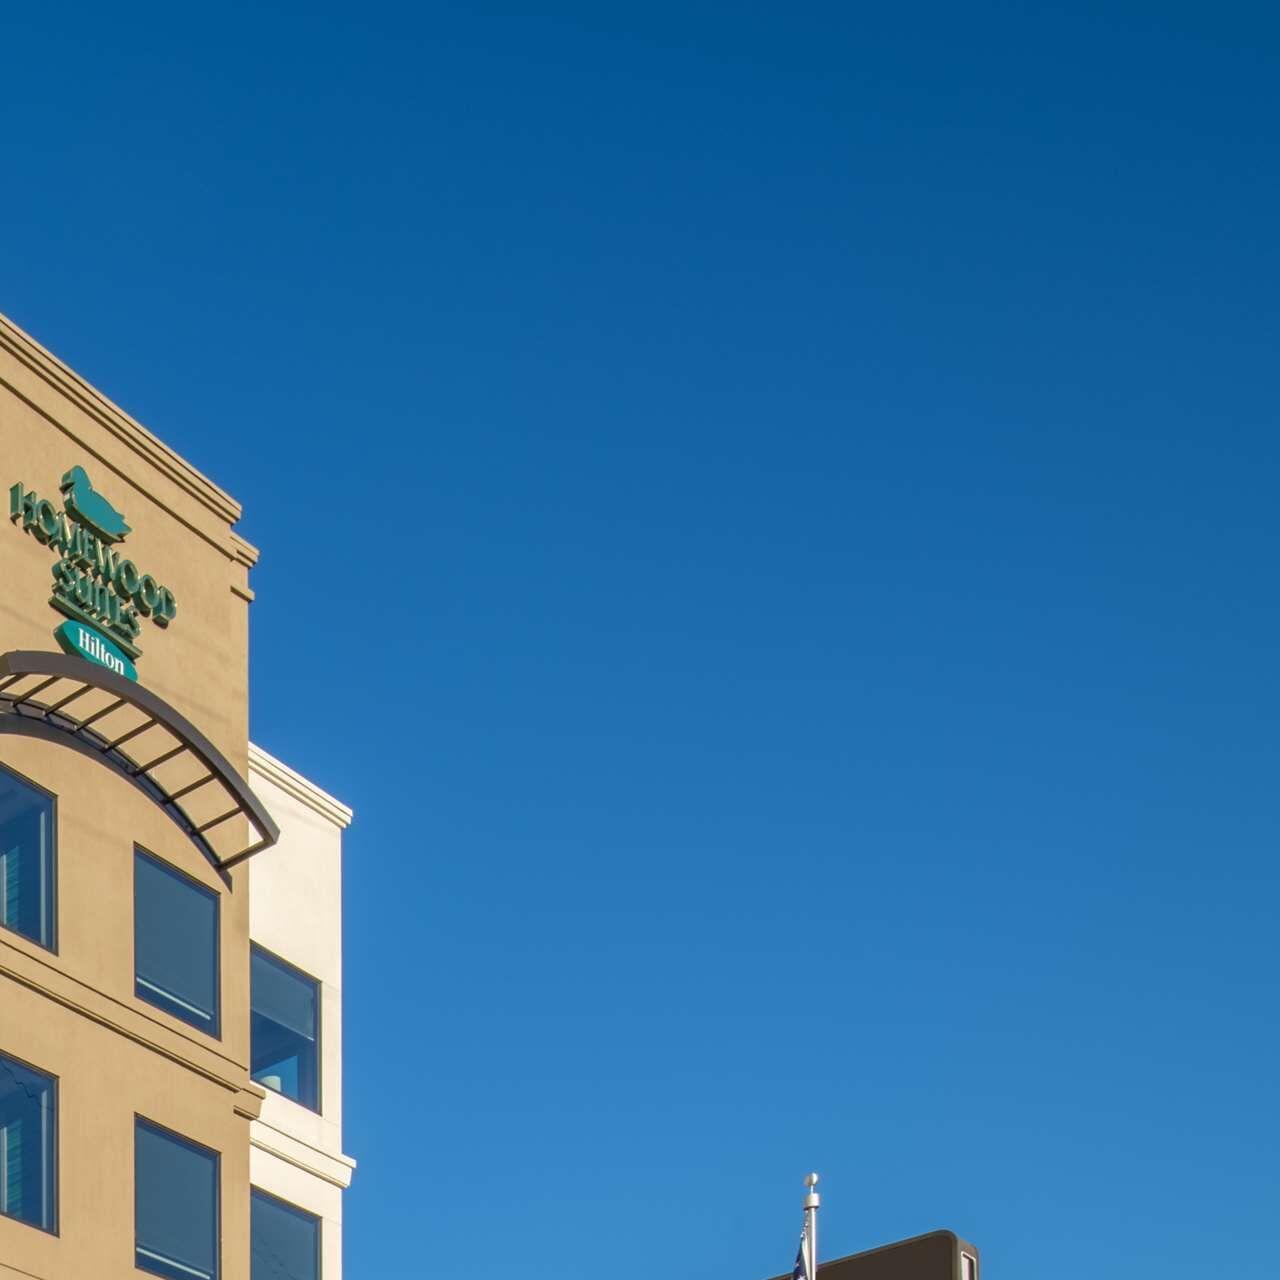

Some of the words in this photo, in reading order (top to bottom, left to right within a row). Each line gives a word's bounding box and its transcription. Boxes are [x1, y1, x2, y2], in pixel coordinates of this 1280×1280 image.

[9, 481, 176, 629] HOMEWOOD
[51, 557, 141, 641] SUITES
[77, 627, 125, 676] Hilton
